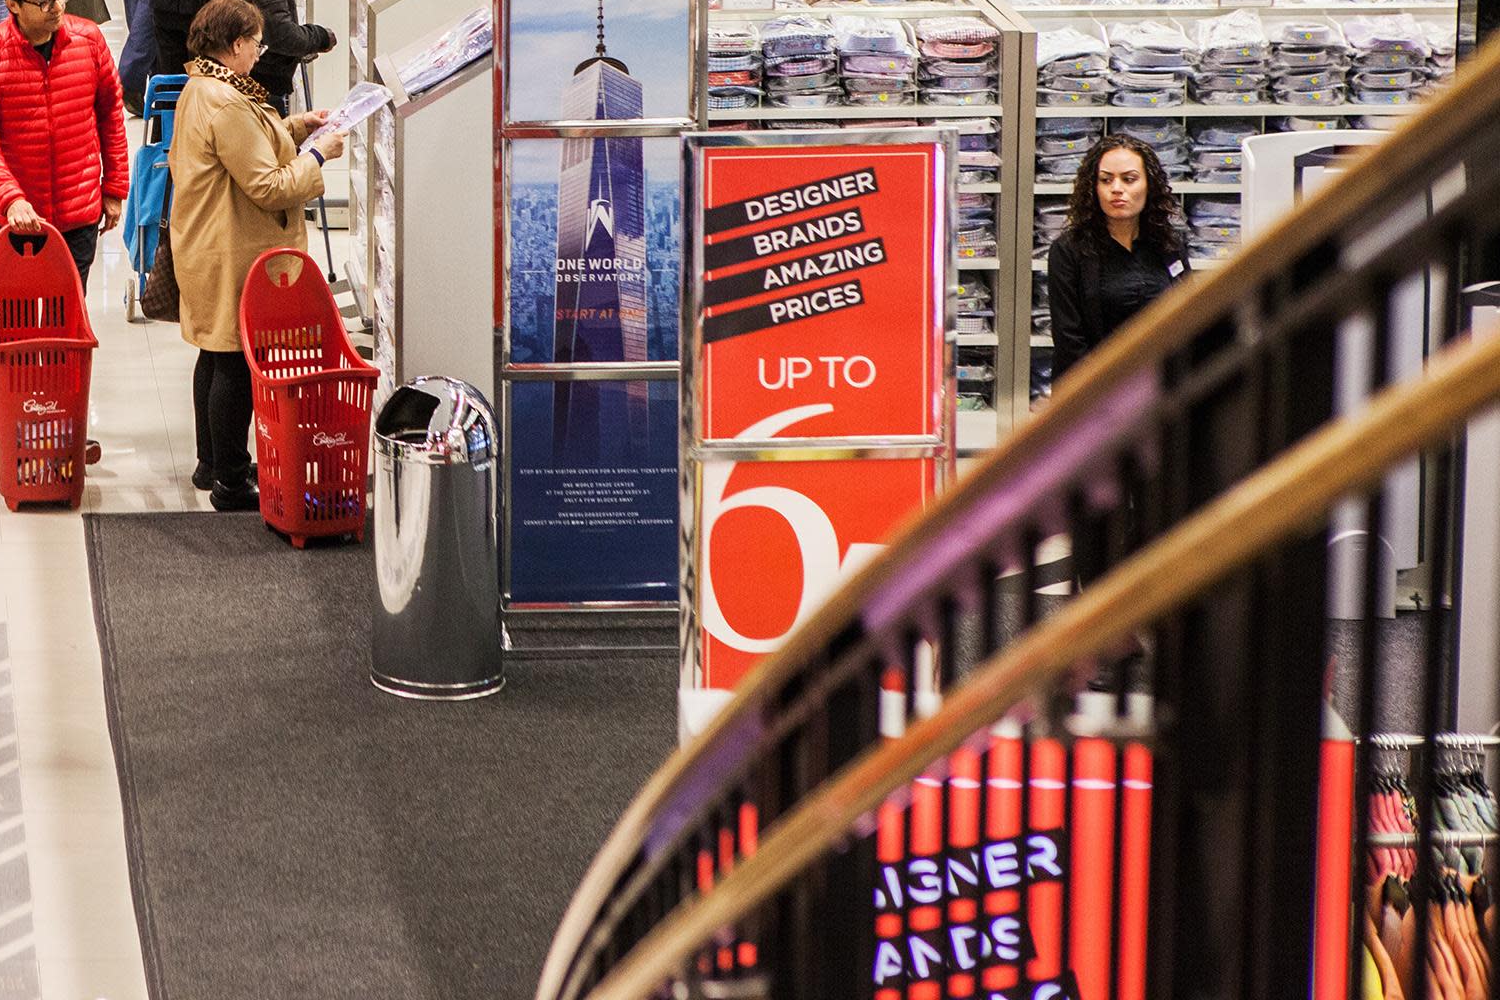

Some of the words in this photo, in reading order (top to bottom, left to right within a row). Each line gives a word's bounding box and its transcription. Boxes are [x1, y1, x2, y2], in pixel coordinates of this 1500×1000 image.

[745, 172, 877, 221] DESIGNER
[753, 212, 861, 256] BRANDS
[556, 258, 586, 270] ONE
[588, 258, 642, 270] WORLD
[556, 273, 642, 282] OBSERVATORY
[763, 243, 884, 290] AMAZING
[556, 308, 597, 320] START
[599, 308, 614, 319] AT
[769, 284, 861, 323] PRICES
[758, 357, 813, 390] UP
[819, 355, 877, 388] TO
